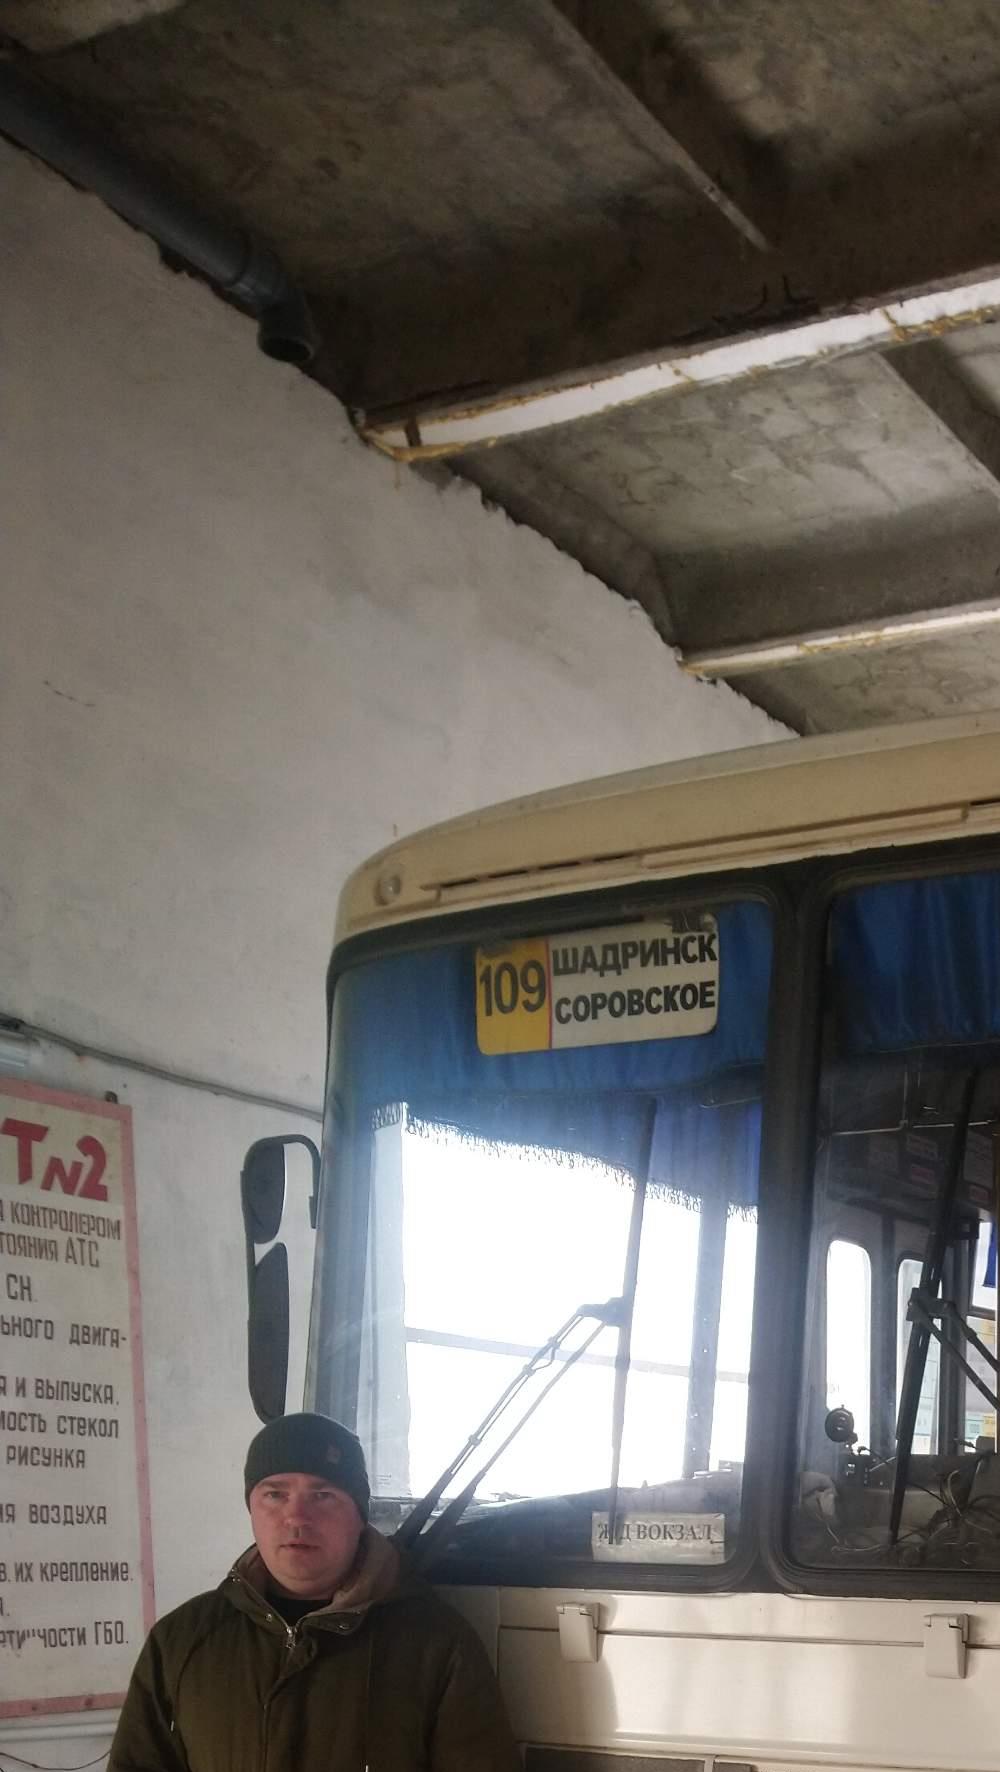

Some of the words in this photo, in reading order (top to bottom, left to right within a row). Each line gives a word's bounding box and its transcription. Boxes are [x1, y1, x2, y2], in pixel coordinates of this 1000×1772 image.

[552, 933, 718, 977] ШАДРИНСК
[479, 960, 547, 1017] 109
[555, 981, 716, 1024] СОРОВСКОЕ
[10, 1201, 121, 1240] КОНТРОЛЕРОМ
[65, 1236, 100, 1268] АТС
[69, 1323, 127, 1348] ДВИГА-
[15, 1377, 26, 1398] И
[6, 1446, 86, 1468] РИСУНКА
[29, 1504, 106, 1525] ВОЗДУХА
[636, 1523, 712, 1541] ВОКЗАЛ
[15, 1562, 33, 1582] ИХ
